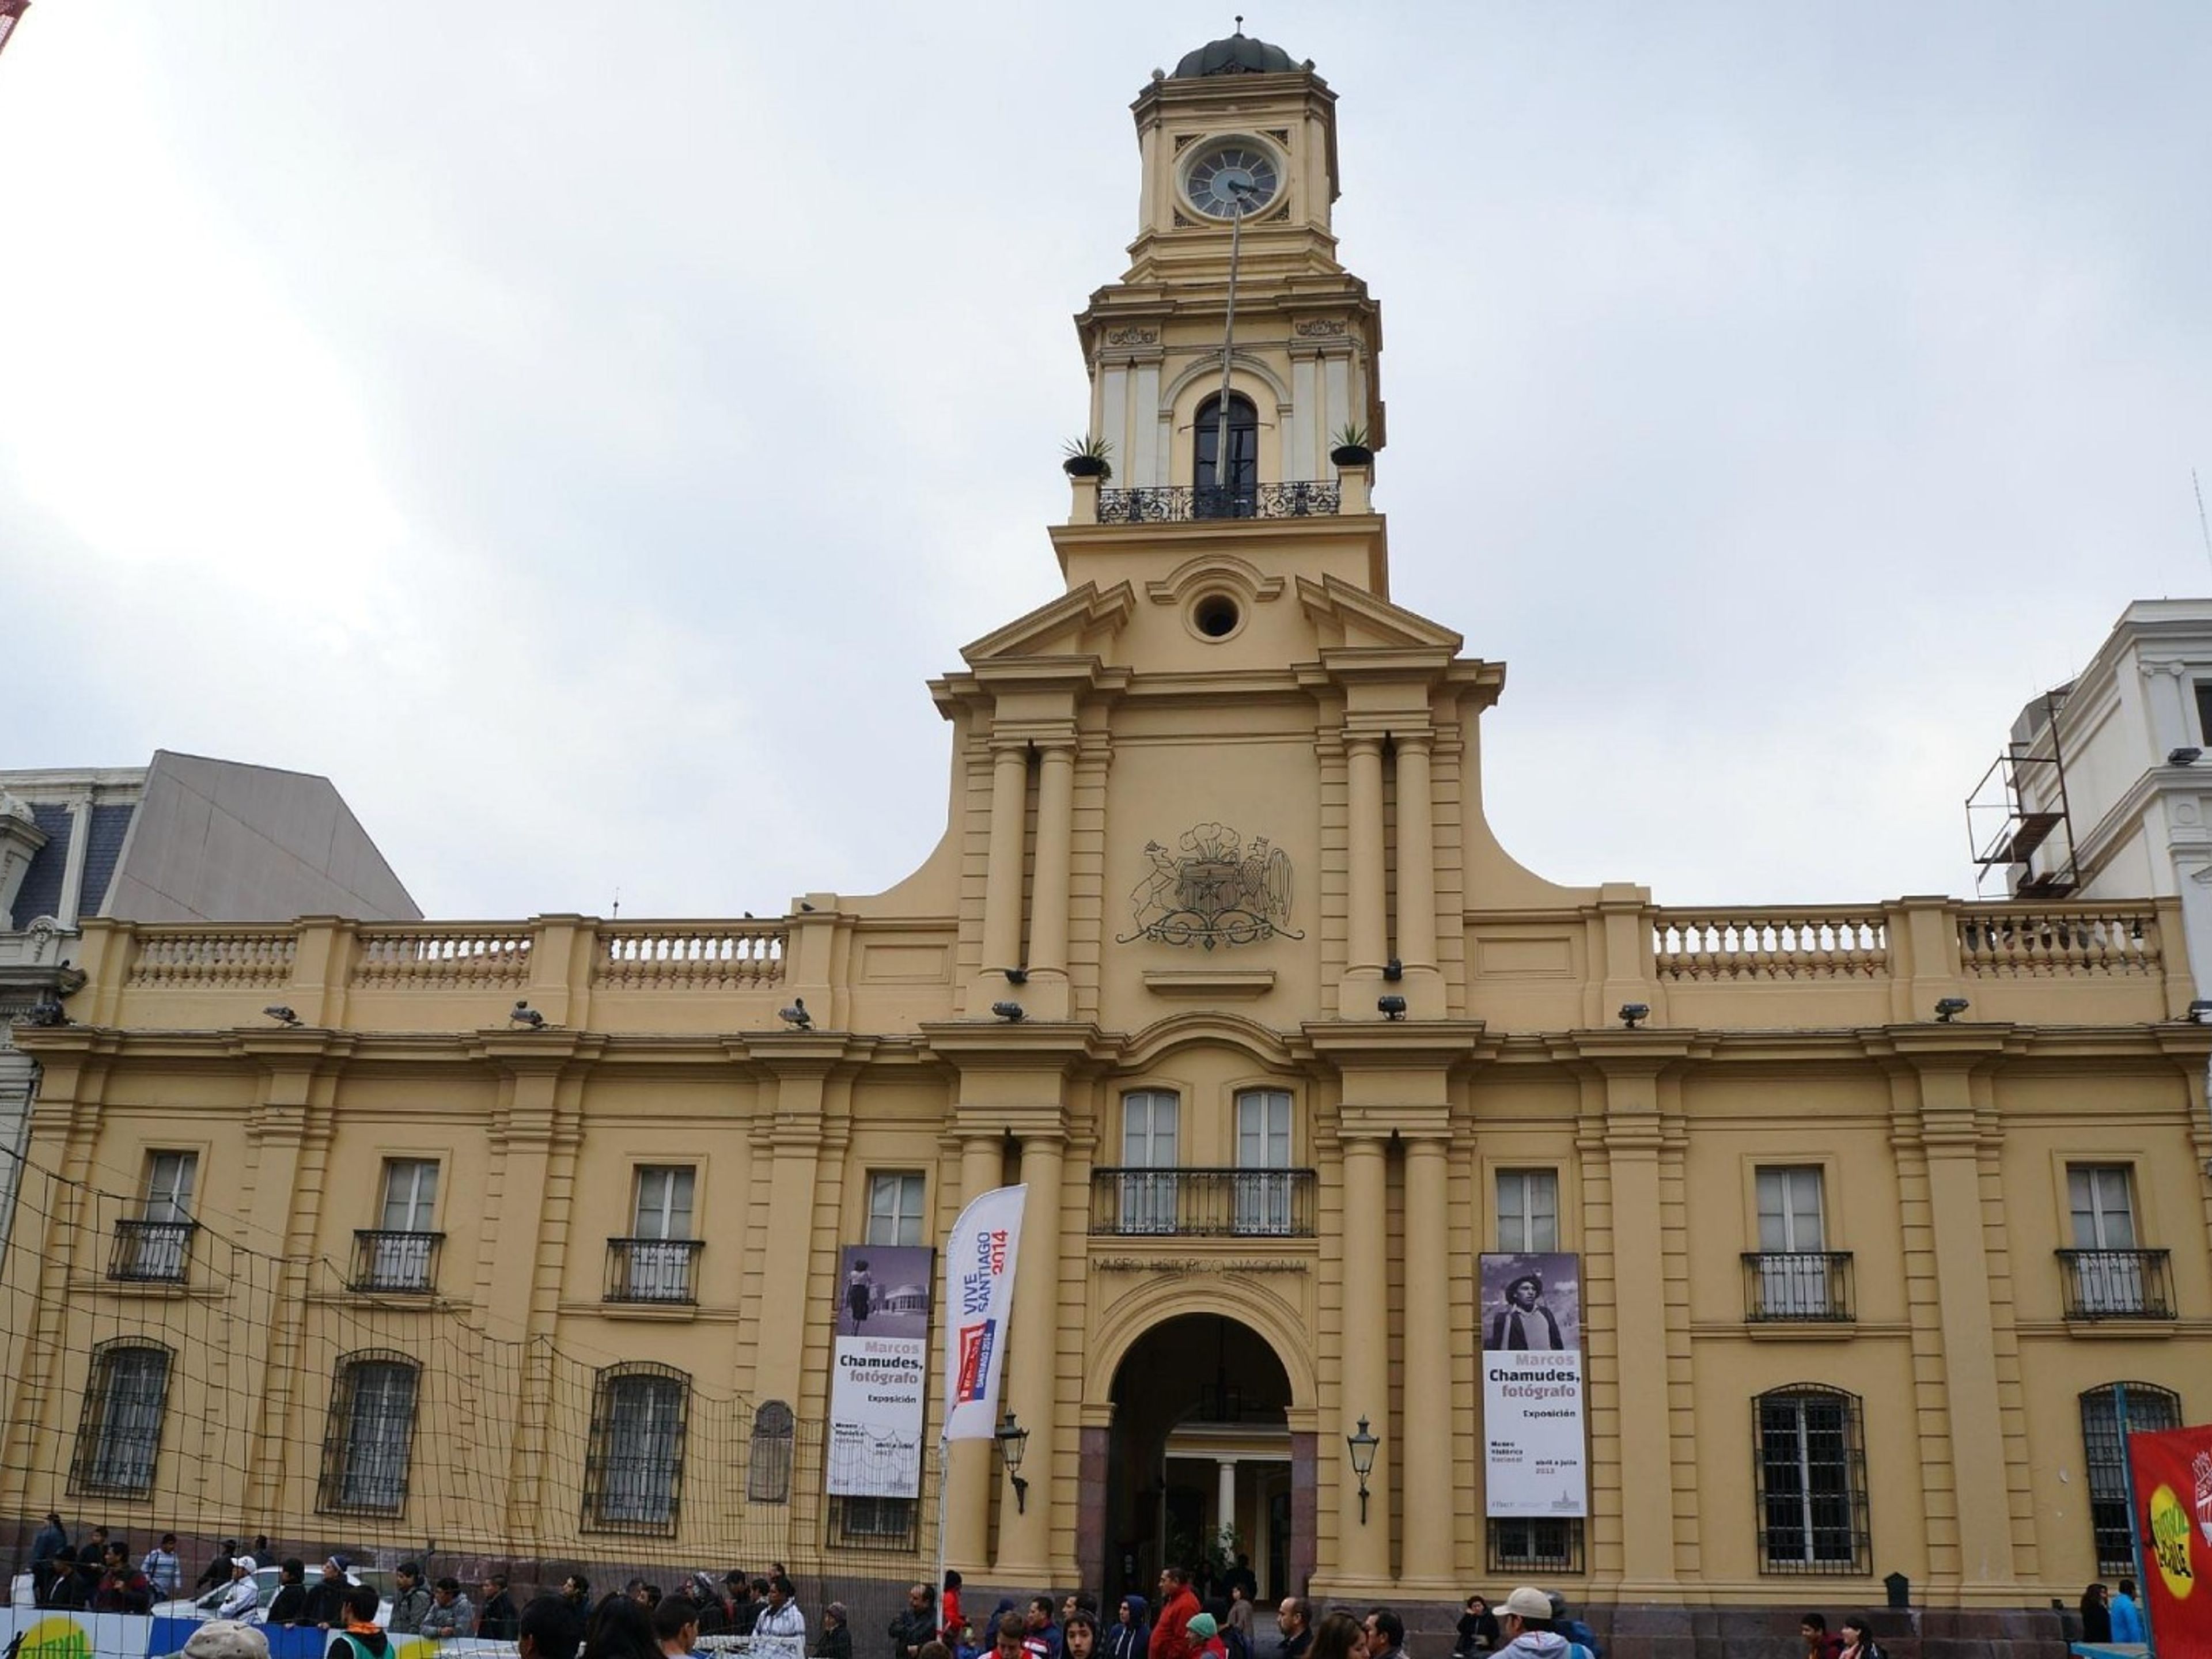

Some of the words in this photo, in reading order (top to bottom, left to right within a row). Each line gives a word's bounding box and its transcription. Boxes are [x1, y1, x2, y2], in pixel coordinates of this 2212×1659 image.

[992, 1230, 1007, 1275] 2014
[976, 1231, 990, 1313] SANTIAGO
[964, 1274, 979, 1316] VIVE
[865, 1342, 919, 1354] Marcos
[840, 1354, 923, 1370] Chamudes,
[1516, 1354, 1575, 1366] Marcos
[850, 1370, 918, 1385] fotógrafo
[1490, 1369, 1580, 1384] Chamudes,
[868, 1394, 916, 1404] Exposición
[1502, 1384, 1576, 1400] fotógrafo
[1523, 1409, 1576, 1419] Exposición
